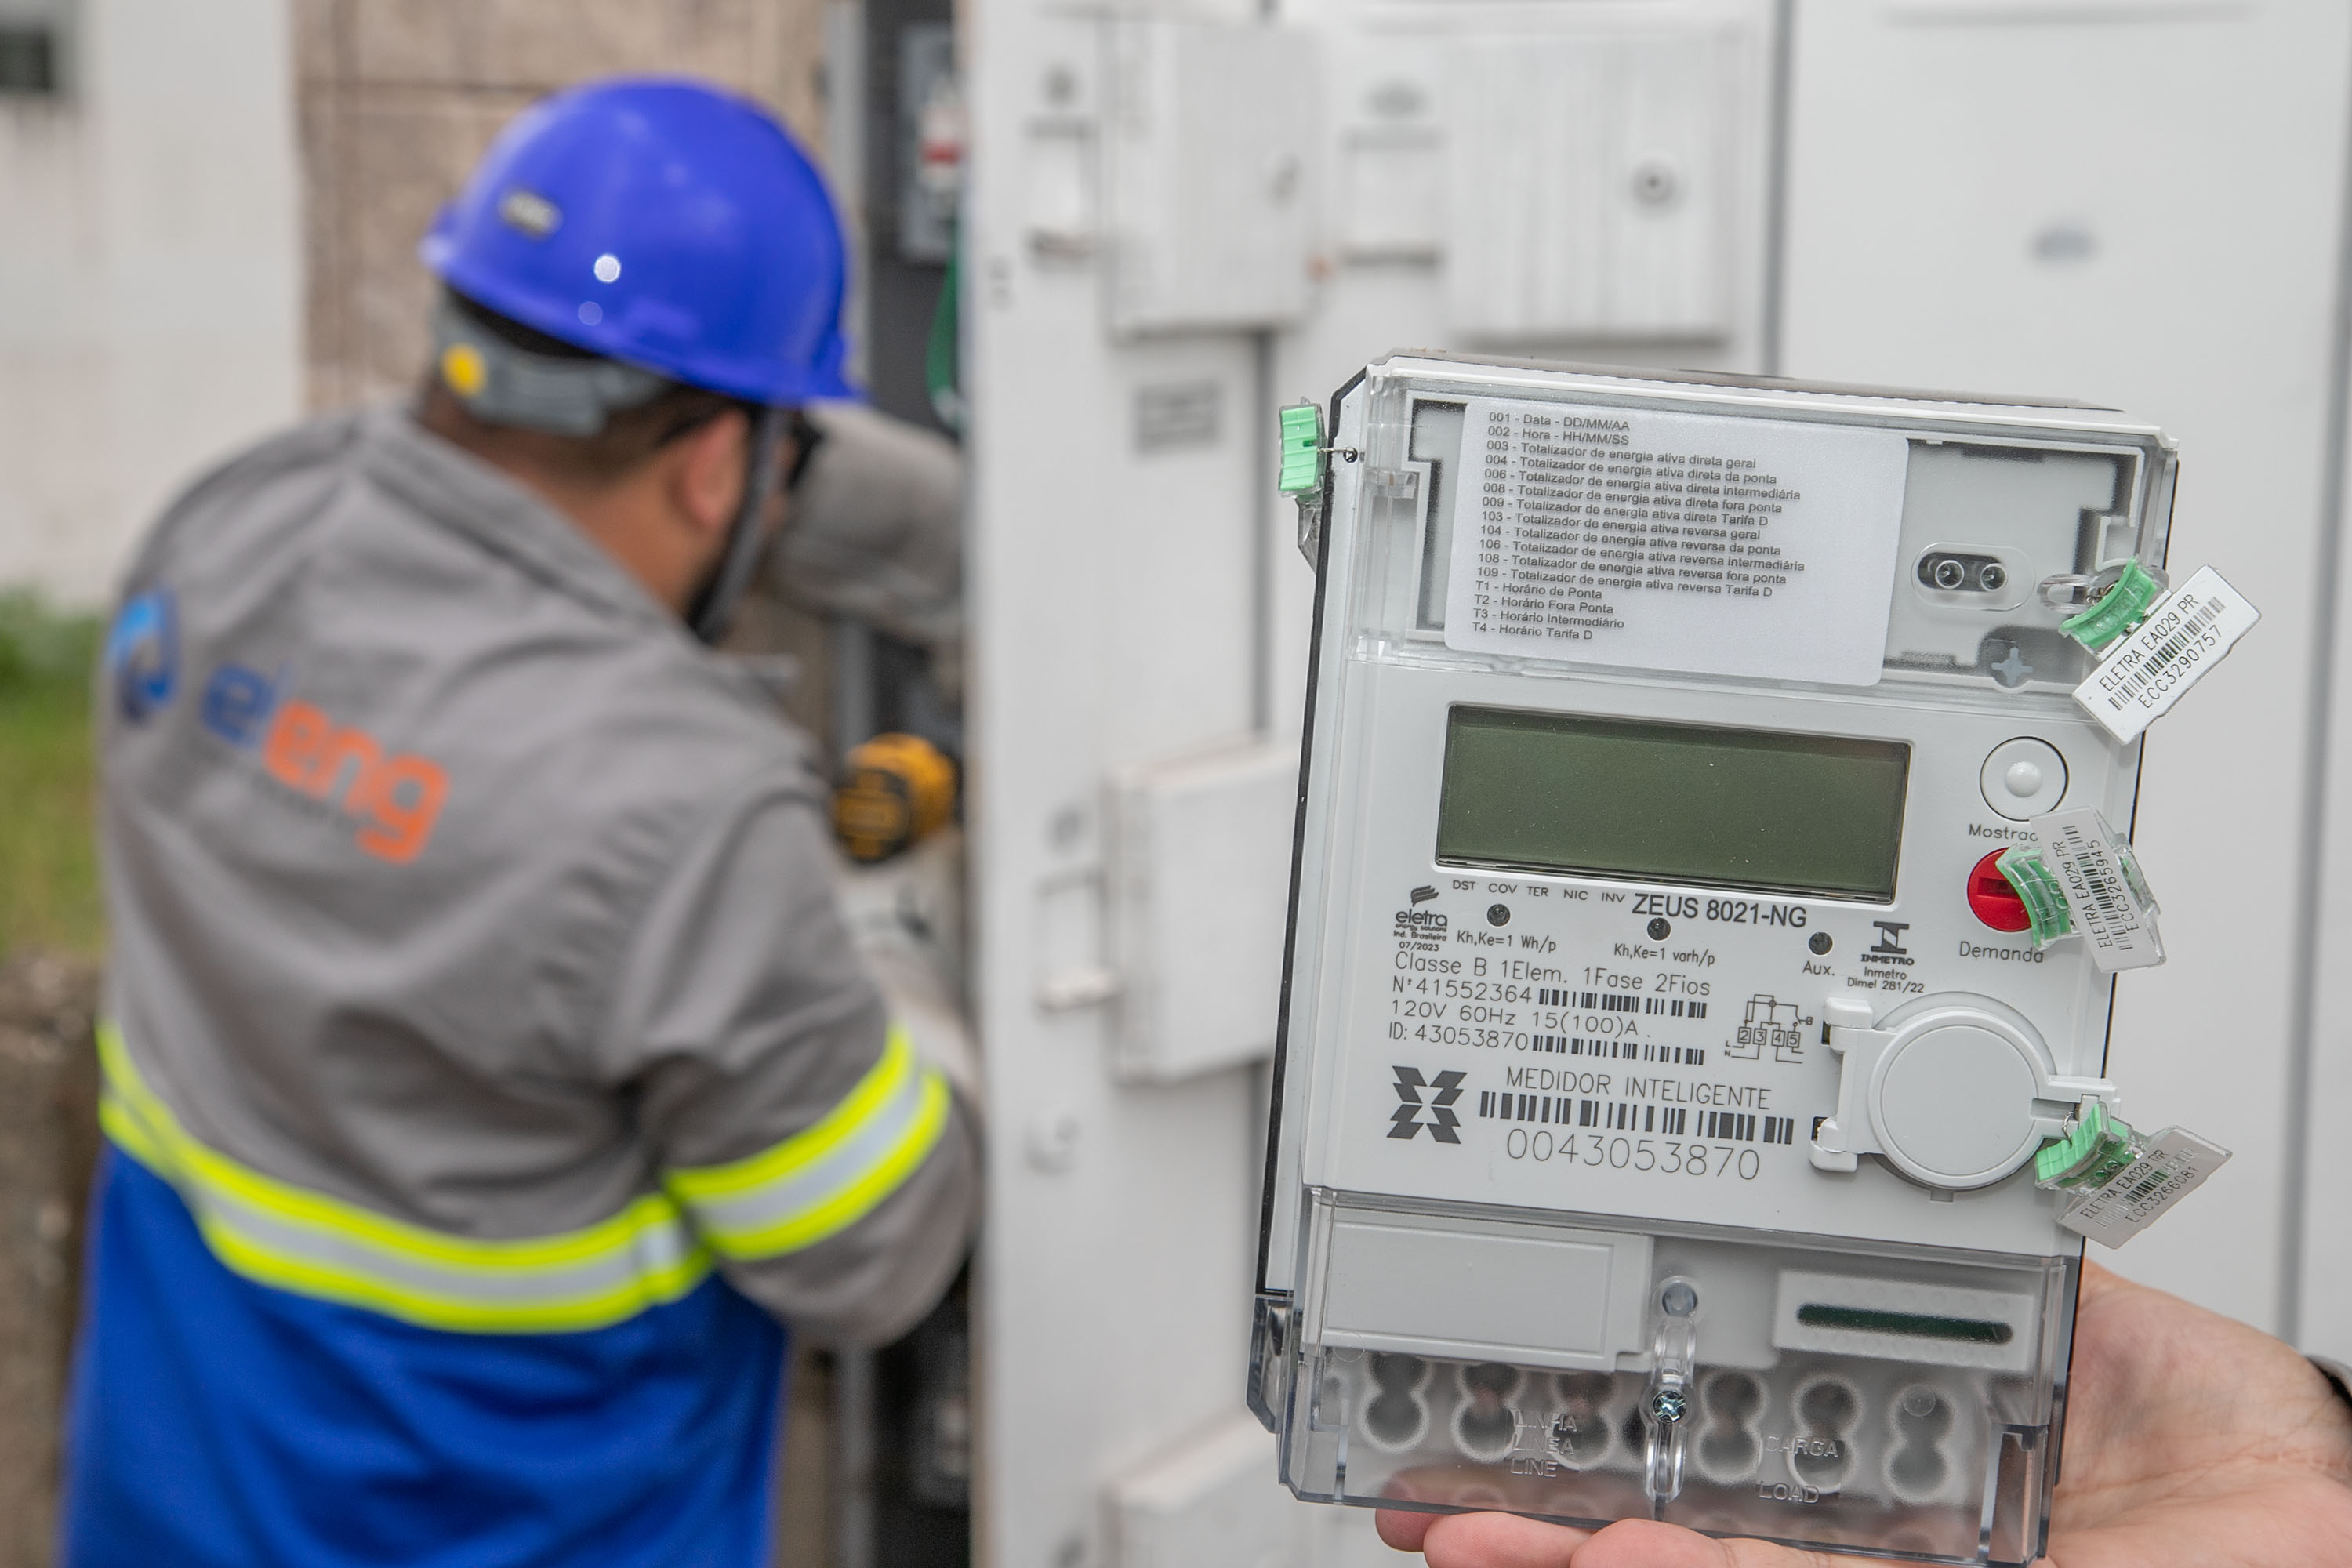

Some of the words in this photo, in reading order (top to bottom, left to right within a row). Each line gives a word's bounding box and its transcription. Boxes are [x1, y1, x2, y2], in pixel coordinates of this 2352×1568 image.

[1487, 426, 1510, 437] 002
[1522, 428, 1551, 440] Hora
[1563, 431, 1629, 445] HH/MM/SS
[1489, 412, 1510, 423] 001
[1523, 413, 1552, 426] Data
[1563, 416, 1630, 431] DD/MM/AA
[1486, 440, 1509, 451] 003
[1521, 442, 1587, 456] Totalizador
[1590, 448, 1606, 458] de
[1609, 451, 1653, 463] energia
[1657, 452, 1686, 464] ativa
[1689, 454, 1722, 466] direta
[1726, 459, 1756, 470] geral
[1486, 454, 1508, 466] 004
[1519, 456, 1586, 471] Totalizador
[1588, 462, 1604, 472] de
[1607, 465, 1652, 477] energia
[1656, 467, 1684, 478] ativa
[1687, 469, 1721, 481] direta
[1725, 471, 1740, 482] da
[1743, 474, 1777, 485] ponta
[1483, 482, 1506, 493] 008
[1517, 485, 1584, 499] Totalizador
[1586, 490, 1602, 500] de
[1605, 493, 1650, 506] energia
[1653, 495, 1682, 506] ativa
[1685, 497, 1719, 509] direta
[1722, 499, 1745, 510] fora
[1748, 503, 1782, 514] ponta
[1484, 468, 1507, 480] 006
[1519, 470, 1585, 485] Totalizador
[1588, 476, 1603, 487] de
[1606, 479, 1650, 492] energia
[1654, 481, 1682, 492] ativa
[1686, 483, 1719, 495] direta
[1723, 487, 1801, 500] intermediária
[1482, 496, 1504, 507] 009
[1516, 499, 1582, 513] Totalizador
[1585, 504, 1600, 514] de
[1603, 507, 1648, 519] energia
[1652, 510, 1680, 520] ativa
[1683, 511, 1717, 523] direta
[1721, 513, 1755, 525] Tarifa
[1759, 516, 1768, 526] D
[1482, 510, 1503, 521] 103
[1515, 513, 1581, 527] Totalizador
[1584, 518, 1599, 528] de
[1602, 521, 1647, 534] energia
[1650, 523, 1679, 534] ativa
[1682, 527, 1726, 538] reversa
[1730, 530, 1761, 541] geral
[1481, 524, 1502, 535] 104
[1514, 526, 1580, 541] Totalizador
[1582, 532, 1598, 543] de
[1601, 535, 1646, 547] energia
[1649, 537, 1678, 548] ativa
[1681, 541, 1726, 552] reversa
[1729, 543, 1744, 553] da
[1747, 546, 1781, 556] ponta
[1479, 539, 1501, 550] 106
[1512, 540, 1579, 555] Totalizador
[1581, 546, 1596, 557] de
[1600, 550, 1644, 561] energia
[1648, 552, 1676, 562] ativa
[1679, 555, 1724, 565] reversa
[1727, 557, 1805, 572] intermediária
[1479, 553, 1500, 564] 108
[1512, 554, 1577, 569] Totalizador
[1580, 560, 1595, 571] de
[1599, 564, 1643, 575] energia
[1646, 565, 1675, 576] ativa
[1679, 569, 1723, 579] reversa
[1726, 570, 1749, 582] fora
[1752, 575, 1787, 584] ponta
[1475, 580, 1490, 591] T1
[1502, 583, 1546, 595] Horário
[1549, 586, 1564, 597] de
[1567, 587, 1602, 599] Ponta
[1478, 566, 1499, 578] 109
[1511, 568, 1576, 583] Totalizador
[1579, 574, 1594, 585] de
[1598, 577, 1642, 590] energia
[1646, 579, 1674, 590] ativa
[1677, 583, 1722, 593] reversa
[1726, 584, 1759, 597] Tarifa
[1762, 586, 1773, 597] D
[1474, 593, 1490, 605] T2
[1501, 596, 1544, 609] Horário
[1548, 600, 1575, 611] Fora
[1579, 601, 1613, 614] Ponta
[1472, 622, 1487, 633] T4
[1499, 624, 1543, 637] Horário
[1546, 627, 1580, 640] Tarifa
[1583, 630, 1593, 641] D
[1473, 608, 1489, 619] T3
[1500, 610, 1544, 622] Horário
[1547, 614, 1624, 629] Intermediário
[2099, 649, 2145, 691] ELETRA
[2141, 612, 2181, 651] EA029
[2177, 594, 2200, 615] PR
[2138, 625, 2223, 709] ECC3290757
[2052, 840, 2067, 858] PR
[1453, 880, 1476, 891] DST
[1488, 883, 1517, 894] COV
[1526, 886, 1549, 897] TER
[1563, 889, 1588, 901] NIC
[1602, 892, 1625, 902] INV
[2062, 862, 2090, 899] EA029
[2086, 840, 2140, 932] ECC3265945
[1395, 908, 1448, 928] eletra
[1632, 893, 1698, 919] ZEUS
[1706, 899, 1806, 928] 8021-NG
[2082, 903, 2113, 948] ELETRA
[1399, 941, 1439, 952] 07/2023
[1457, 930, 1512, 947] Kh,Ke=1
[1521, 935, 1556, 953] Wh/p
[1614, 943, 1665, 960] Kh,Ke=1
[1672, 949, 1715, 967] varh/p
[1959, 941, 2044, 964] Demanda
[1396, 951, 1461, 975] Classe
[1474, 957, 1486, 976] B
[1502, 960, 1567, 983] 1Elem.
[1584, 967, 1642, 990] 1Fase
[1655, 973, 1710, 996] 2Fios
[1802, 960, 1835, 976] Aux.
[1860, 953, 1915, 966] INMETRO
[1864, 966, 1907, 982] Inmetro
[1847, 977, 1877, 989] Dimel
[1882, 980, 1924, 993] 281/22
[1392, 1000, 1447, 1018] 120V
[1460, 1005, 1515, 1025] 60Hz
[1533, 1008, 1639, 1038] 15(100)A
[1389, 1022, 1407, 1040] ID:
[1414, 1024, 1528, 1051] 43053870
[1504, 1066, 1610, 1098] MEDIDOR
[1625, 1076, 1772, 1112] INTELIGENTE
[1507, 1127, 1759, 1180] 0043053870
[2080, 1189, 2122, 1219] ELETRA
[2116, 1162, 2154, 1193] EA029
[1766, 1436, 1838, 1458] CARGA
[1510, 1457, 1558, 1478] LINE
[1759, 1481, 1820, 1504] LOAD
